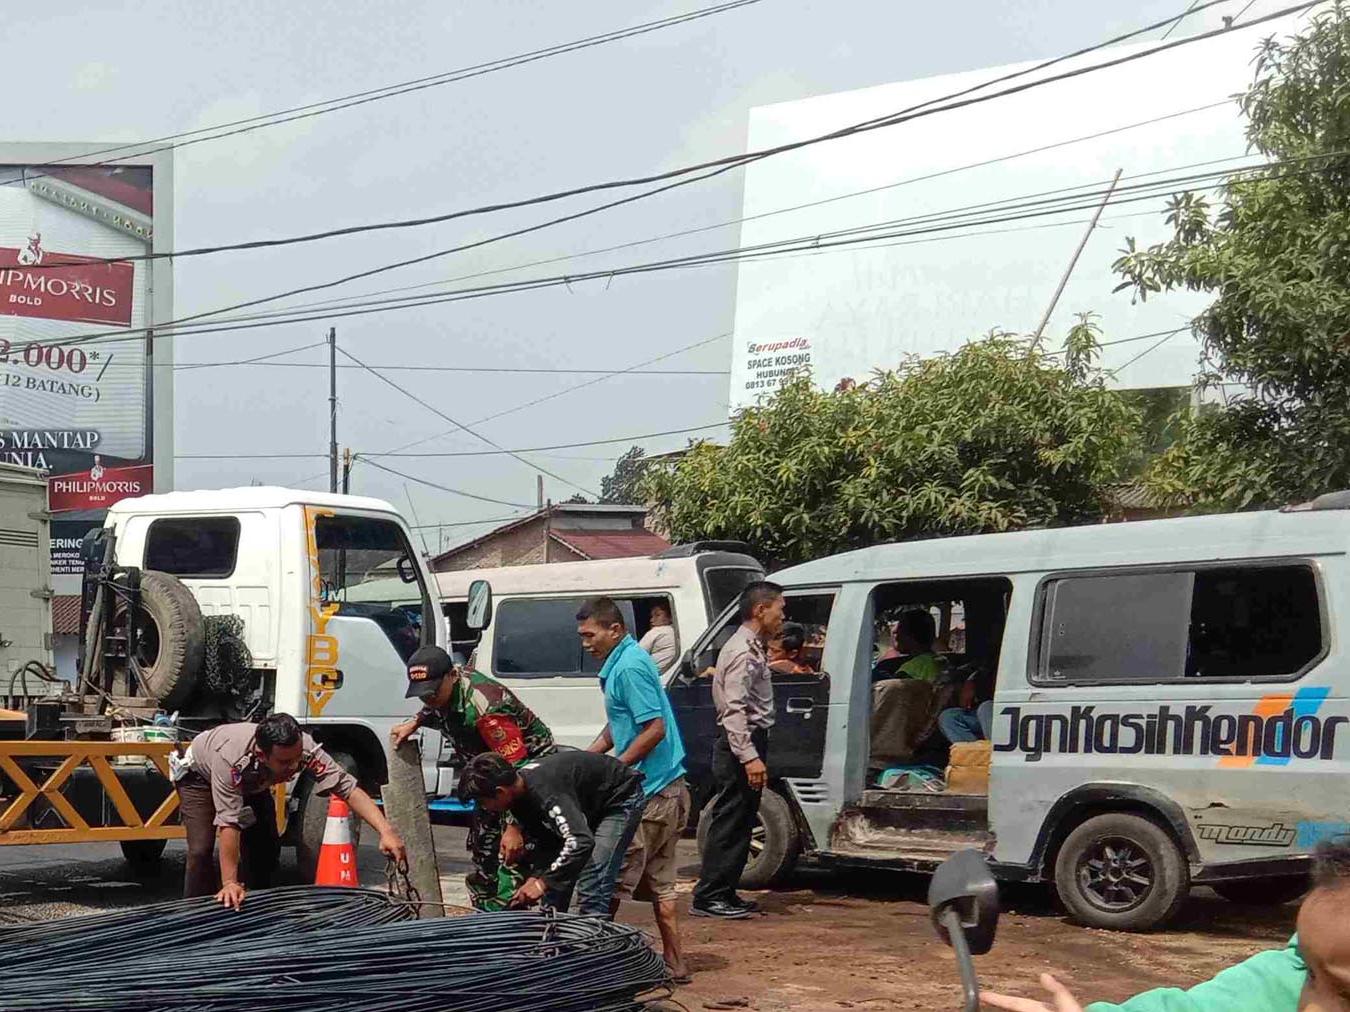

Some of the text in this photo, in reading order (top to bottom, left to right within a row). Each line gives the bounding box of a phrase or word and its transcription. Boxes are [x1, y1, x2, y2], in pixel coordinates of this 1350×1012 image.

[9, 294, 42, 306] BOLD
[747, 353, 811, 370] SPACE KOSONG
[26, 377, 101, 402] BATANG)
[11, 431, 100, 449] MANTAP
[54, 481, 141, 493] PHILIPMORRIS
[50, 538, 83, 548] ERING
